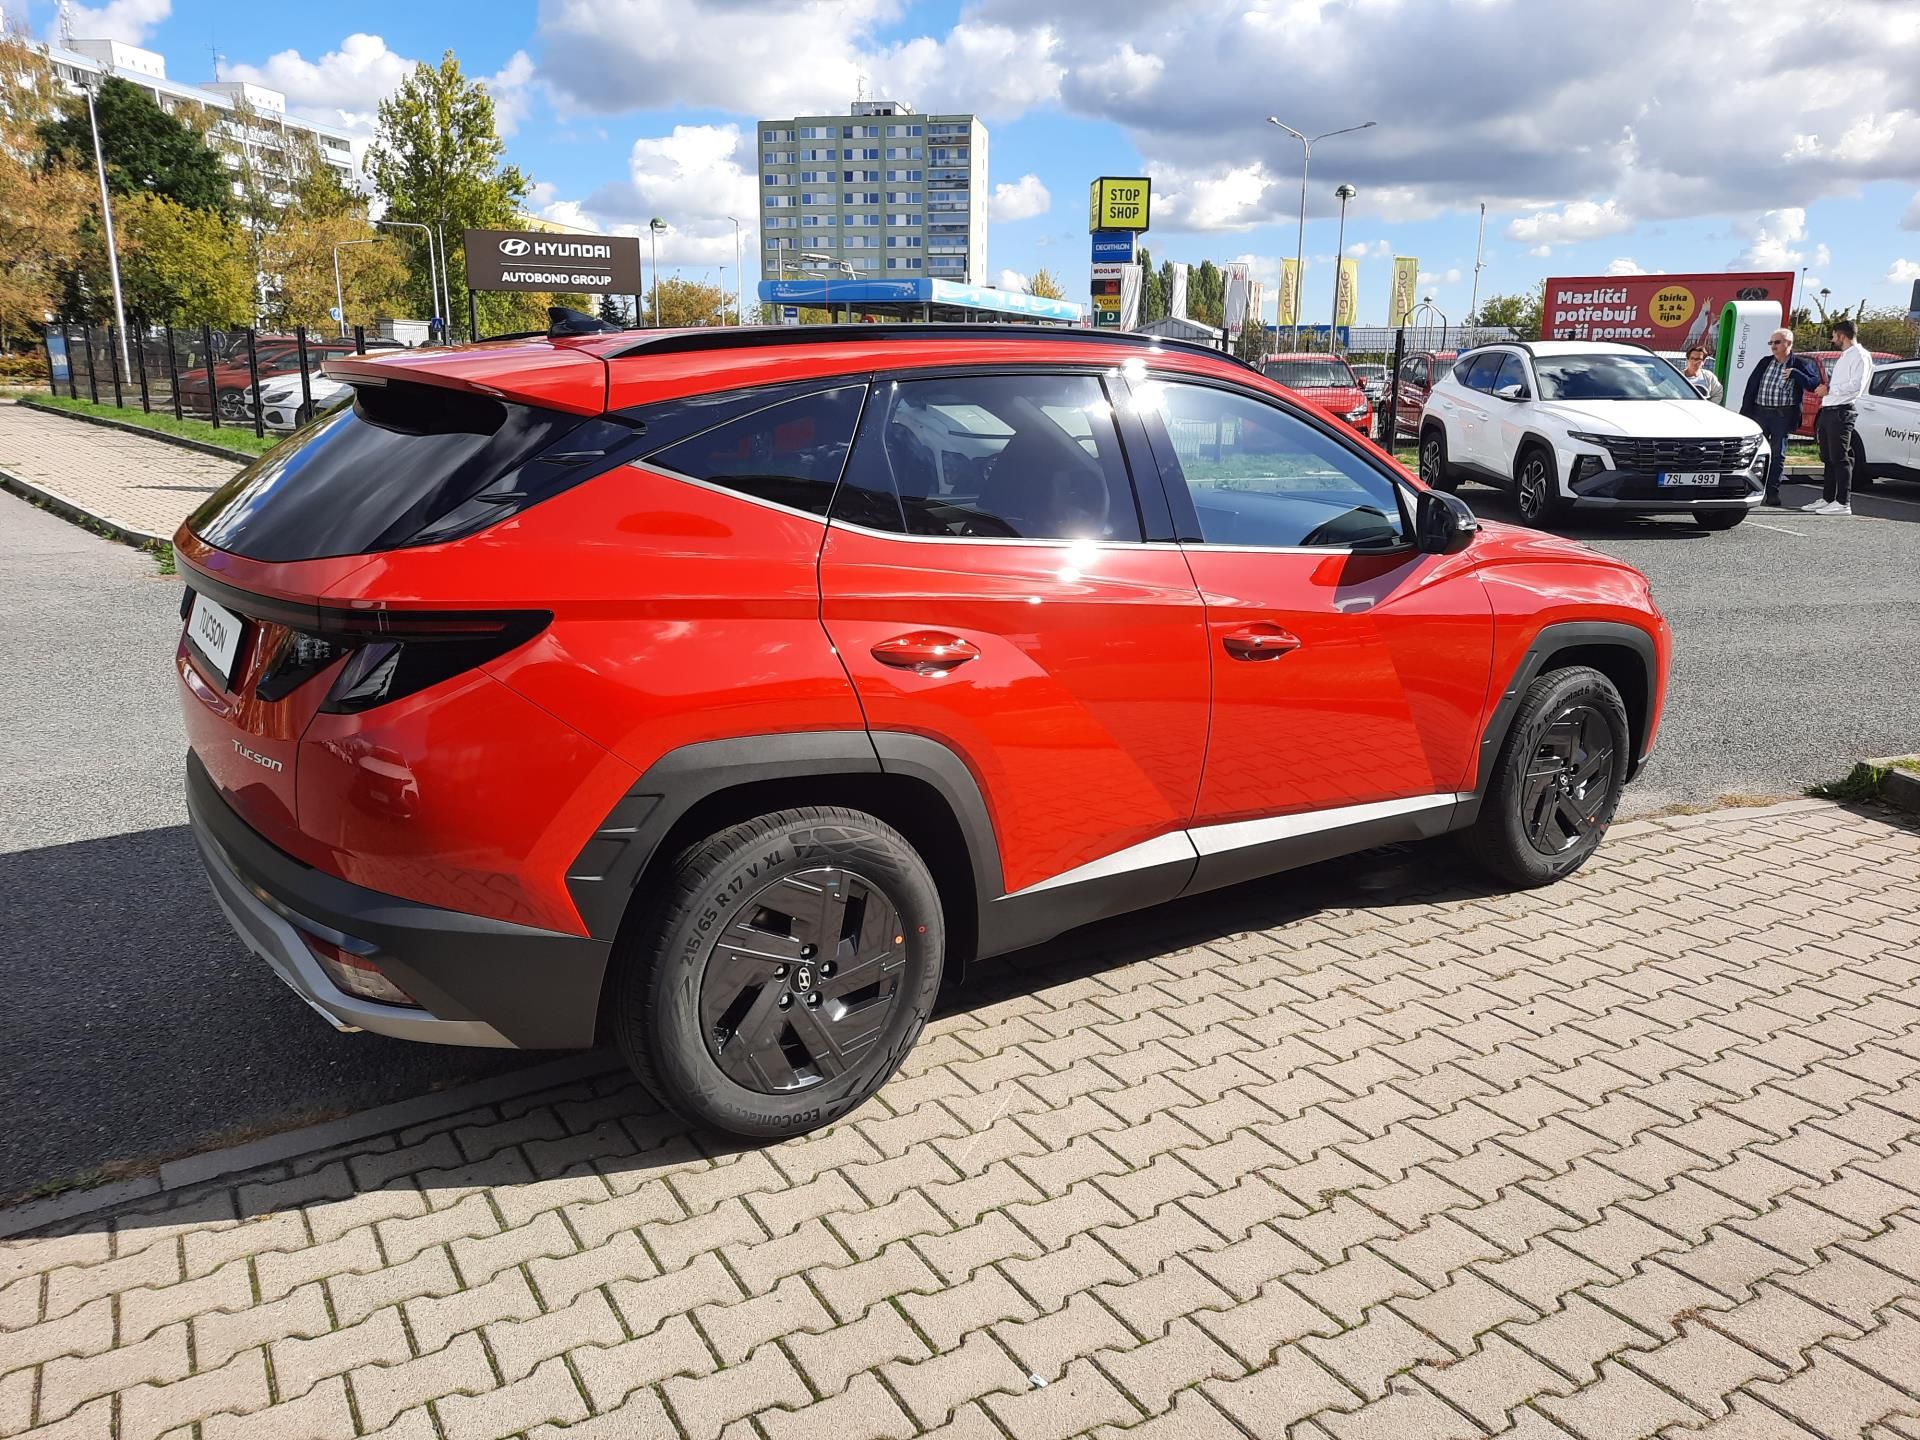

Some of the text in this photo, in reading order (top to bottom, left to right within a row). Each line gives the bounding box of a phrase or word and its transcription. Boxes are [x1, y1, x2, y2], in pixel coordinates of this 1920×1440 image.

[1110, 188, 1140, 201] STOP
[1109, 206, 1139, 219] SHOP
[534, 242, 611, 259] HYUNDAI
[1095, 243, 1130, 251] DECATHLON
[501, 272, 612, 286] AUTOBOND GROUP
[1557, 287, 1628, 304] Mazlíčci
[1676, 303, 1686, 311] 4.
[1106, 312, 1115, 321] D
[1554, 305, 1638, 325] potřebují
[1591, 327, 1656, 341] pomoc.
[1736, 323, 1751, 369] OlifeEnergy
[1884, 426, 1907, 442] Nový
[1666, 474, 1684, 484] 7SL
[1691, 474, 1716, 484] 4993
[199, 606, 228, 654] TUCSON
[680, 850, 786, 967] 215/65 R 17 V XL
